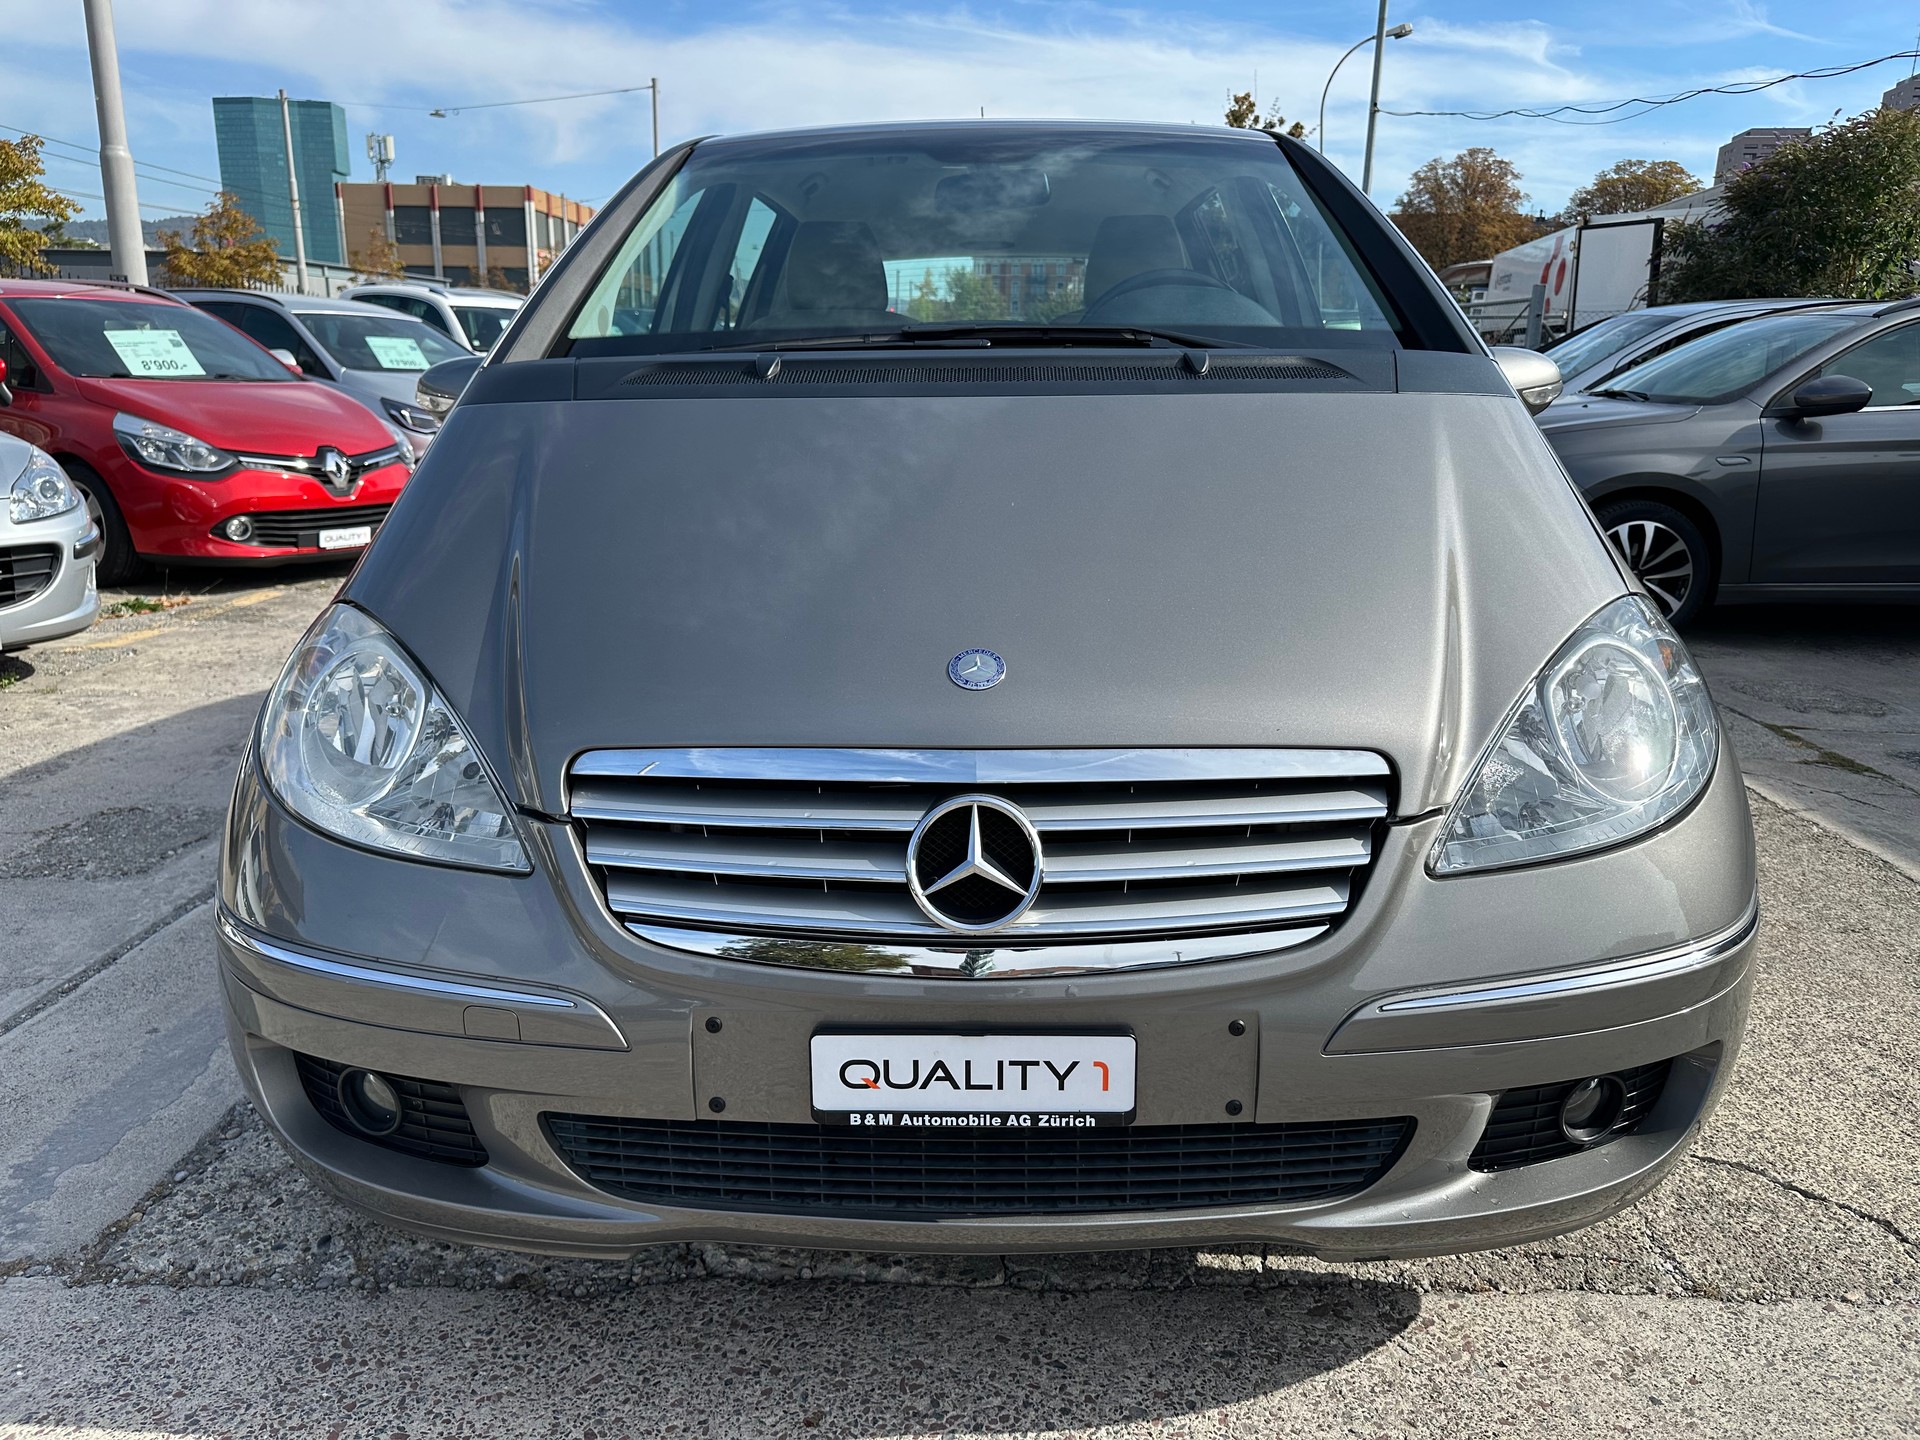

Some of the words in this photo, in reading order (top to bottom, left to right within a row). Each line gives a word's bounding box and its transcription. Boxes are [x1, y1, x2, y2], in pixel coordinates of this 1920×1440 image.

[839, 1059, 1080, 1091] QUALITY
[1092, 1060, 1109, 1091] 1
[900, 1113, 1001, 1127] Automobile
[1006, 1114, 1031, 1127] AG
[1038, 1114, 1096, 1128] Zürich
